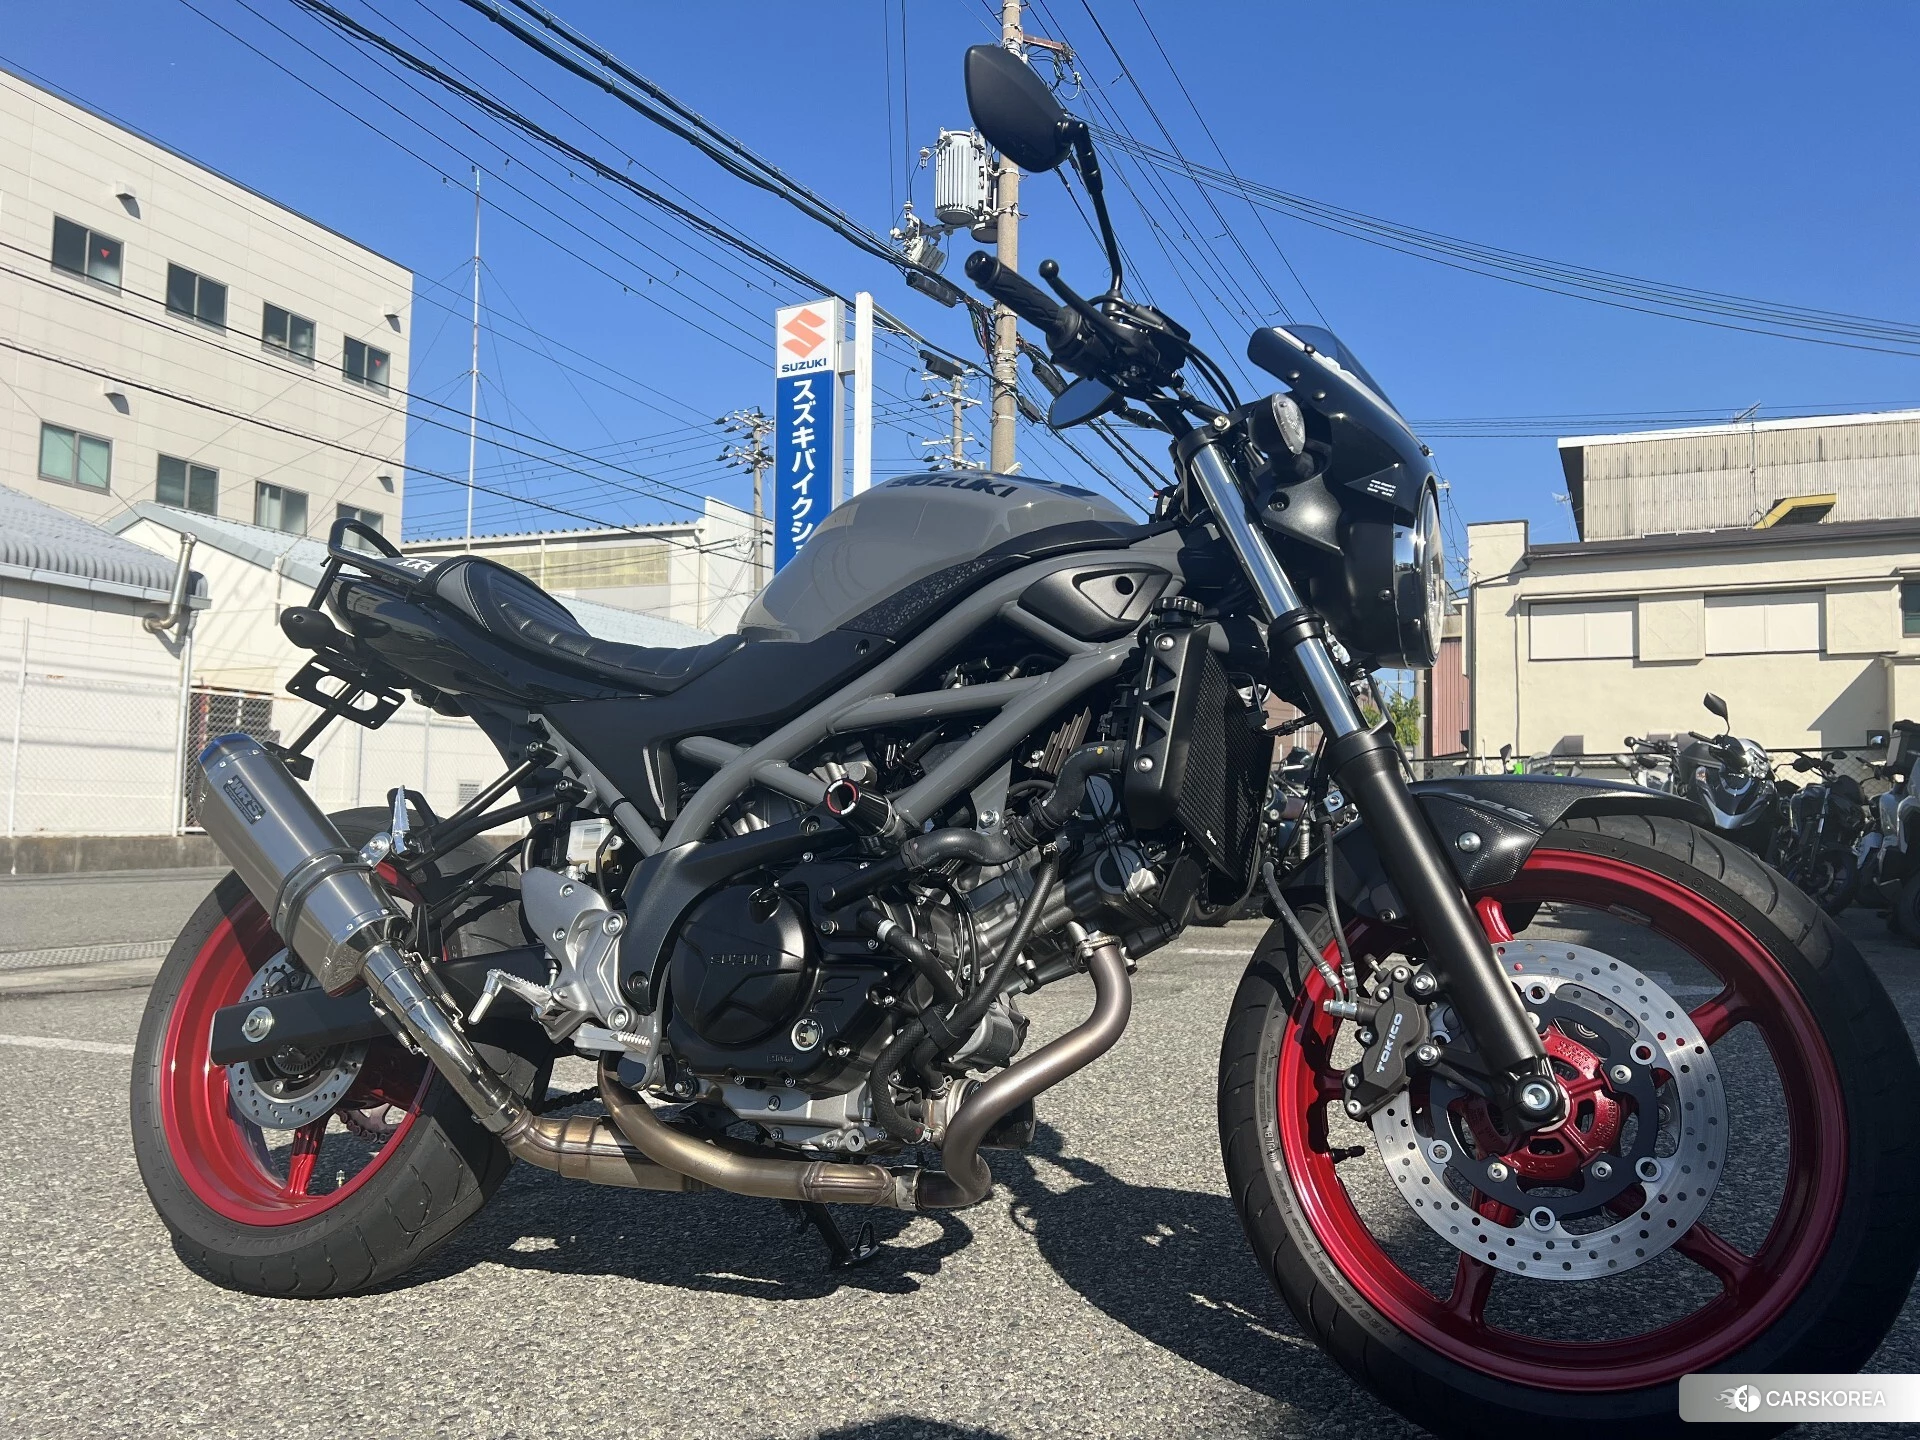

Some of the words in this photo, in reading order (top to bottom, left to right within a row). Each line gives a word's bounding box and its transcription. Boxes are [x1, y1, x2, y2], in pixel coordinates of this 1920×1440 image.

[781, 357, 827, 373] SUZUKI
[791, 379, 817, 555] スズキバイクシ
[886, 474, 1019, 498] SUZUKI
[1376, 1013, 1403, 1073] TOKICO
